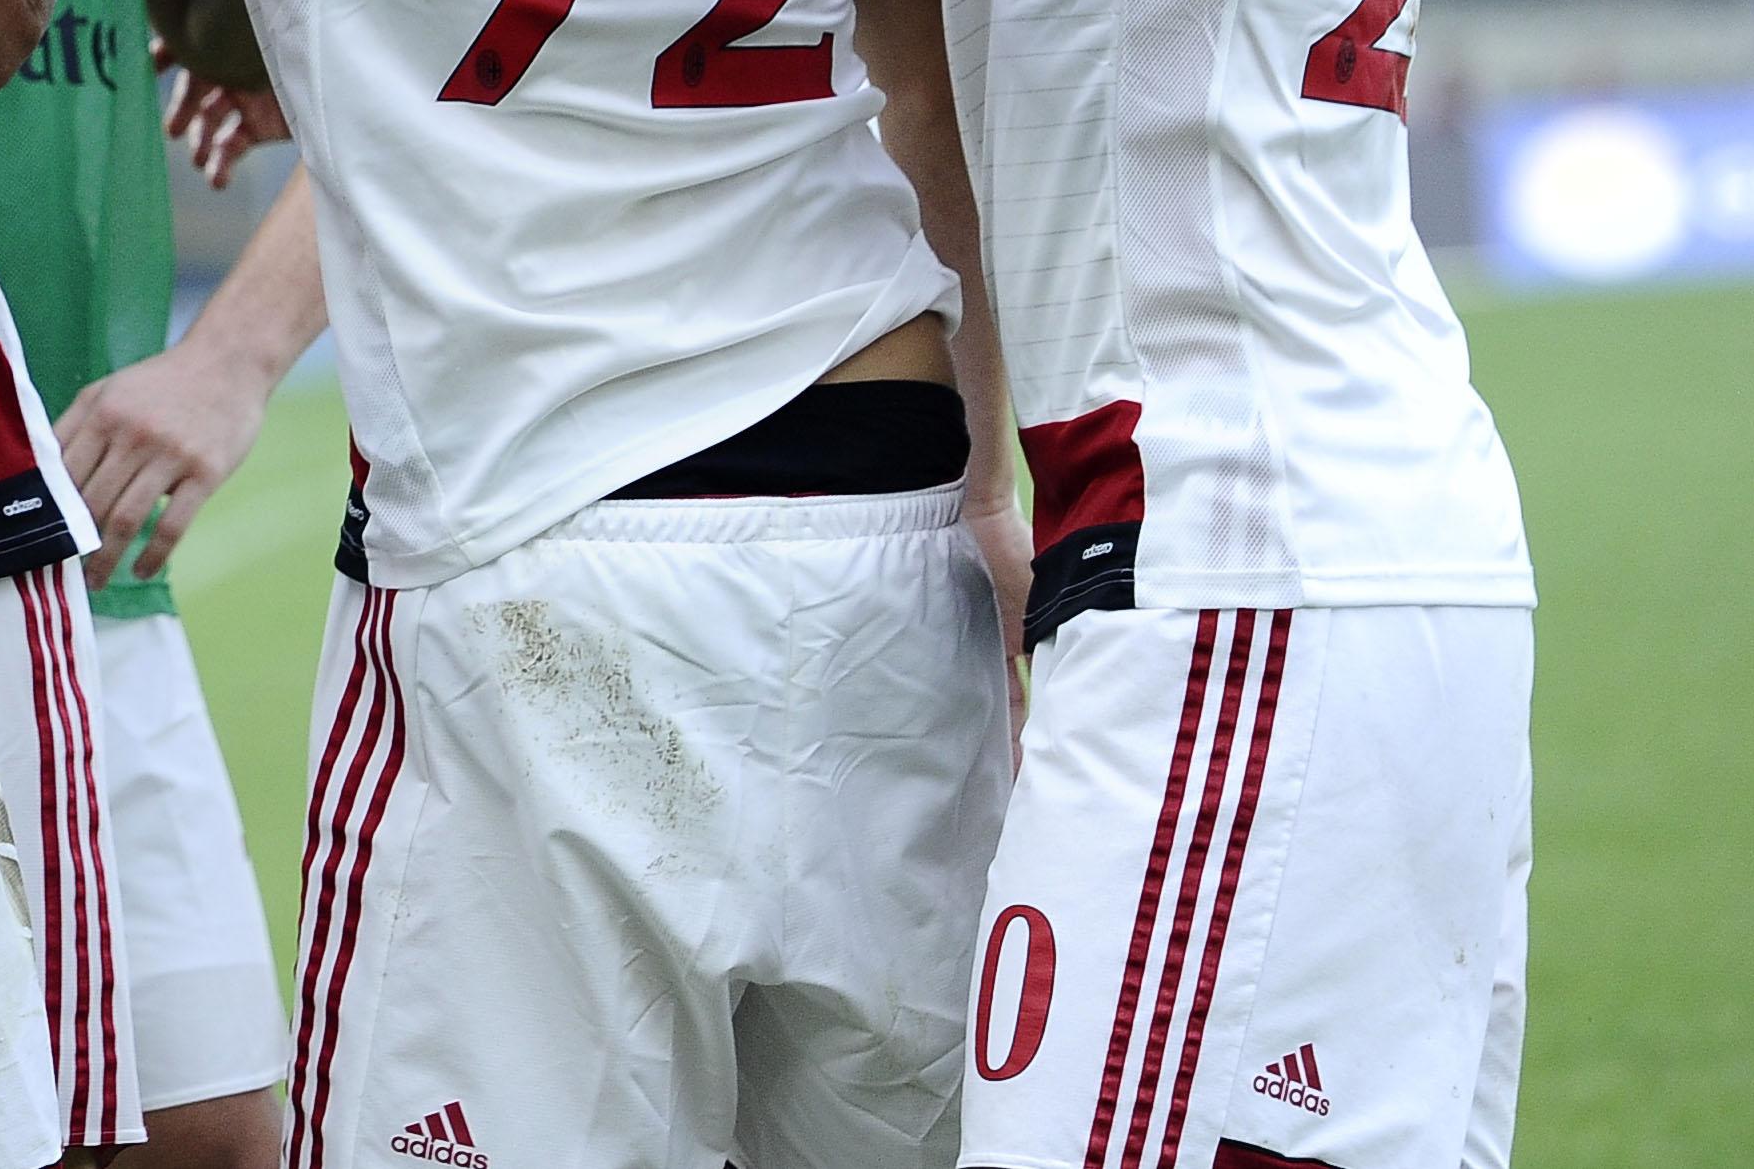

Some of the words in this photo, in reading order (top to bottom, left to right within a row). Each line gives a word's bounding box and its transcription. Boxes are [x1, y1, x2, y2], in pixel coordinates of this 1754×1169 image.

[974, 904, 1057, 1082] 0
[1253, 1075, 1331, 1117] adidas
[390, 1135, 489, 1169] adidas
